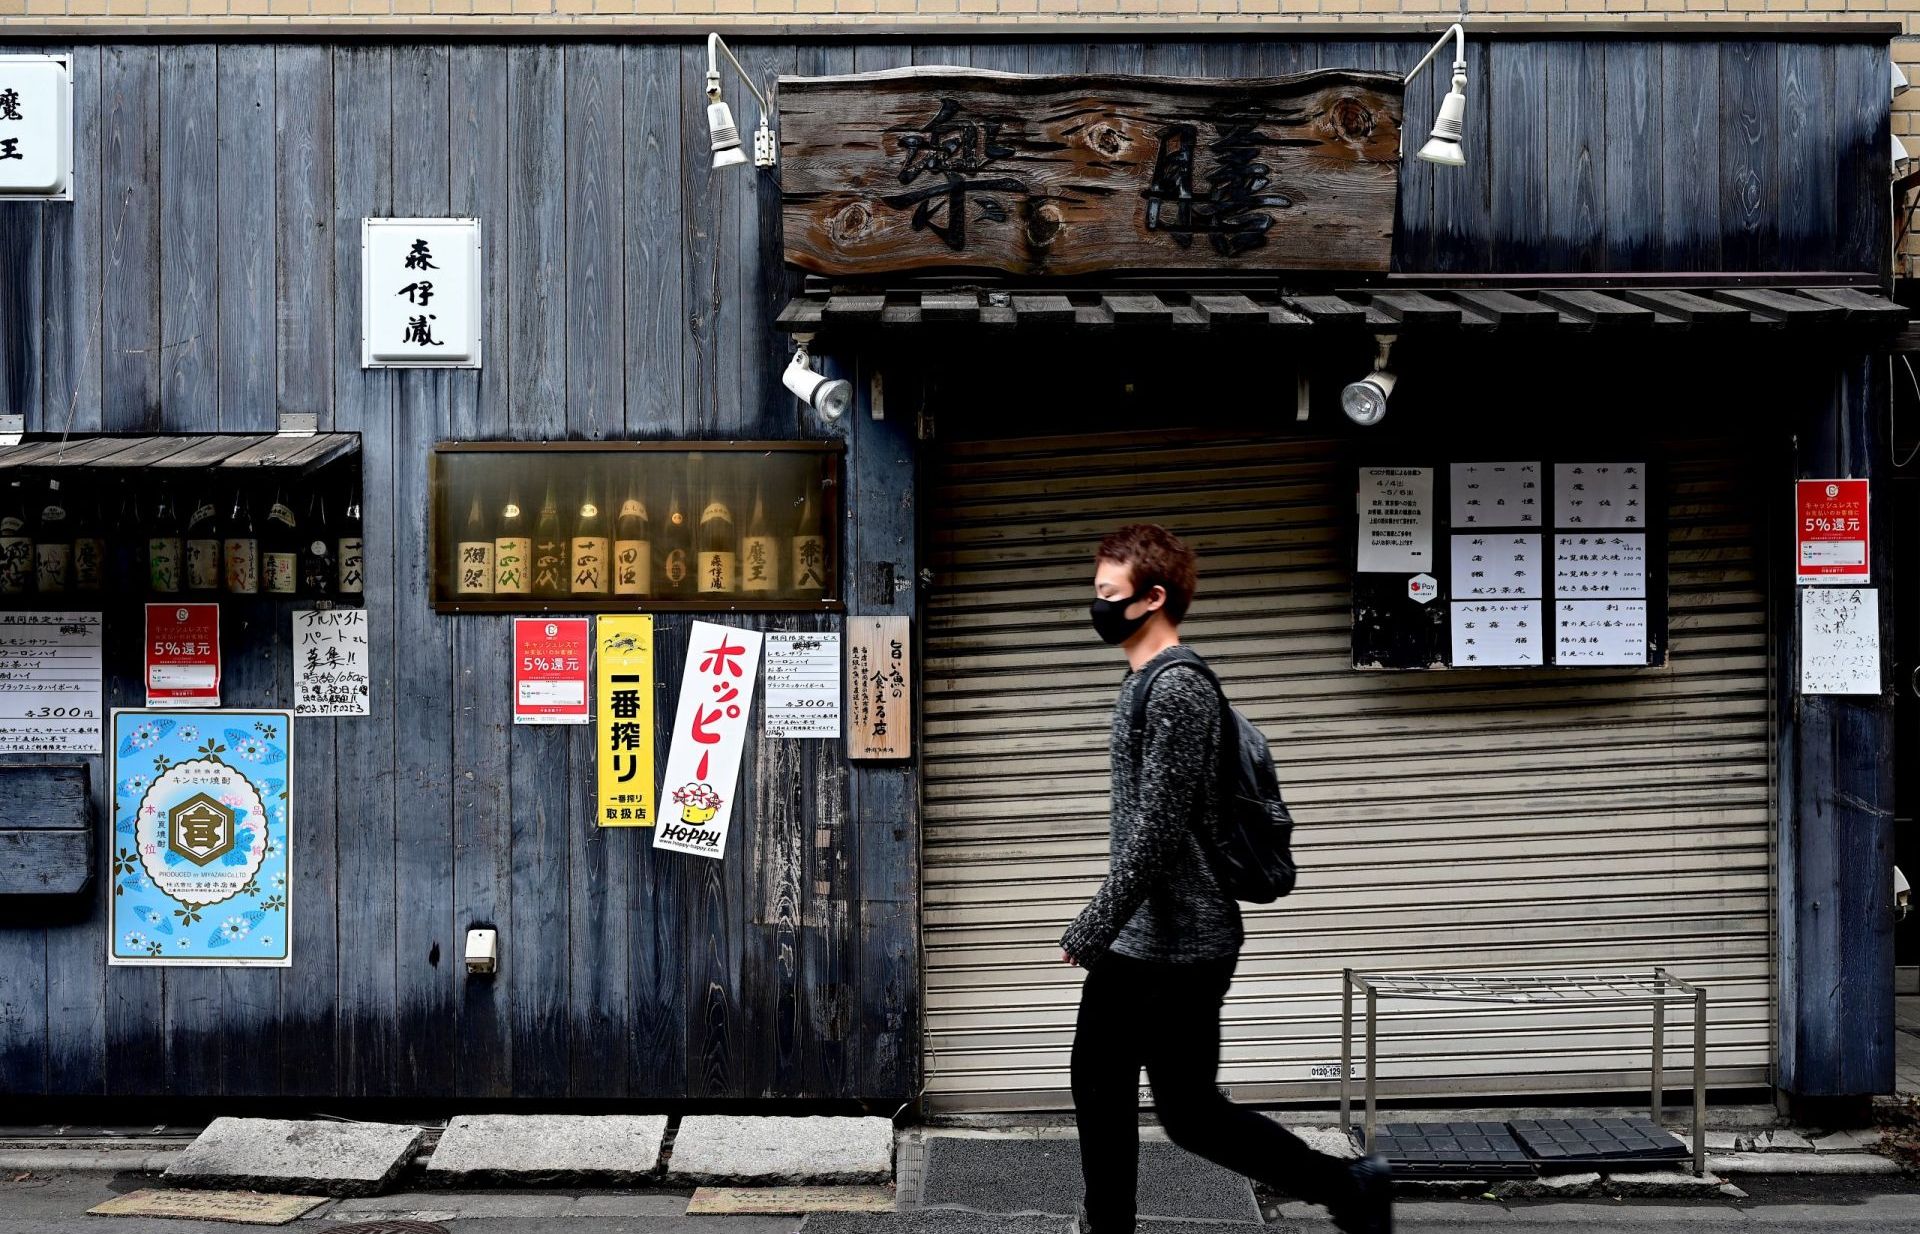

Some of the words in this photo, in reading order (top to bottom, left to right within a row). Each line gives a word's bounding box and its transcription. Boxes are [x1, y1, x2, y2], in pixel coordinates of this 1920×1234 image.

[1805, 518, 1860, 532] 5%還元
[498, 541, 521, 589] 十四代
[576, 541, 598, 589] 十四代
[1422, 583, 1435, 591] Pay
[299, 610, 364, 627] アルバイト
[154, 642, 211, 656] 5%還元
[523, 657, 580, 671] 5%還元
[889, 639, 905, 698] 旨い魚の
[691, 633, 746, 781] ホッピー
[870, 670, 888, 736] 食える店
[611, 674, 640, 783] 一番搾り
[172, 776, 232, 785] キンミヤ焼酎
[610, 794, 643, 803] 一番搾り
[606, 808, 646, 820] 取扱店
[660, 823, 721, 846] Hoppy
